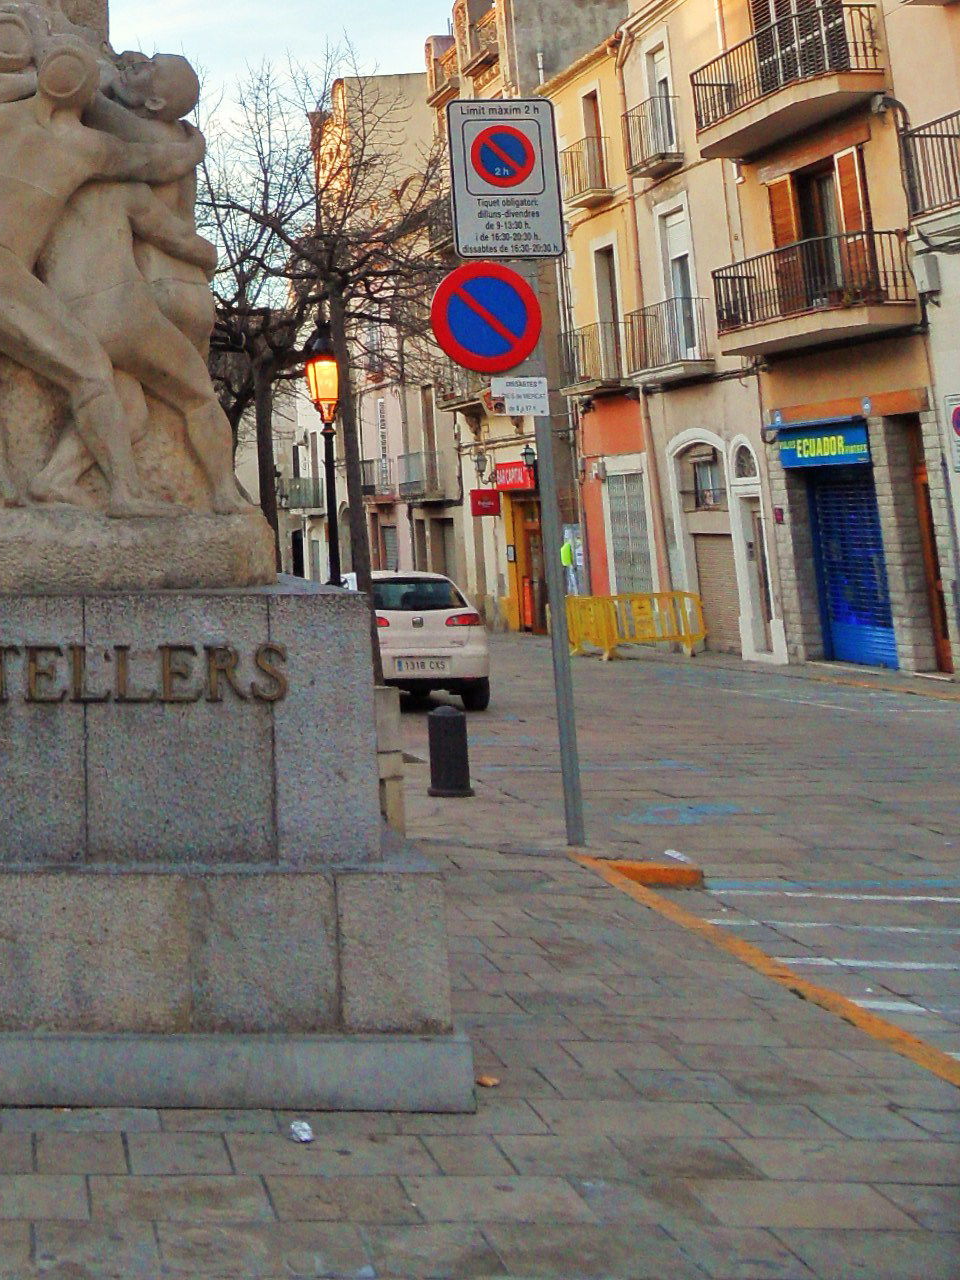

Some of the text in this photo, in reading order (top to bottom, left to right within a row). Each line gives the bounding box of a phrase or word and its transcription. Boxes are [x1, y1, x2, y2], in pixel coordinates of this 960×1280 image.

[524, 105, 530, 114] 2
[533, 105, 540, 114] h
[494, 167, 509, 176] 2 h
[477, 198, 500, 208] Tiquet
[477, 209, 540, 219] dilluns-divendres
[485, 221, 494, 230] de
[496, 220, 523, 230] 9-13:30
[480, 232, 489, 241] de
[492, 232, 532, 242] 16:30-20:30
[462, 244, 497, 254] dissabtes
[499, 243, 509, 253] de
[511, 243, 551, 253] 16:30-20:30
[796, 435, 845, 458] ECUADOR
